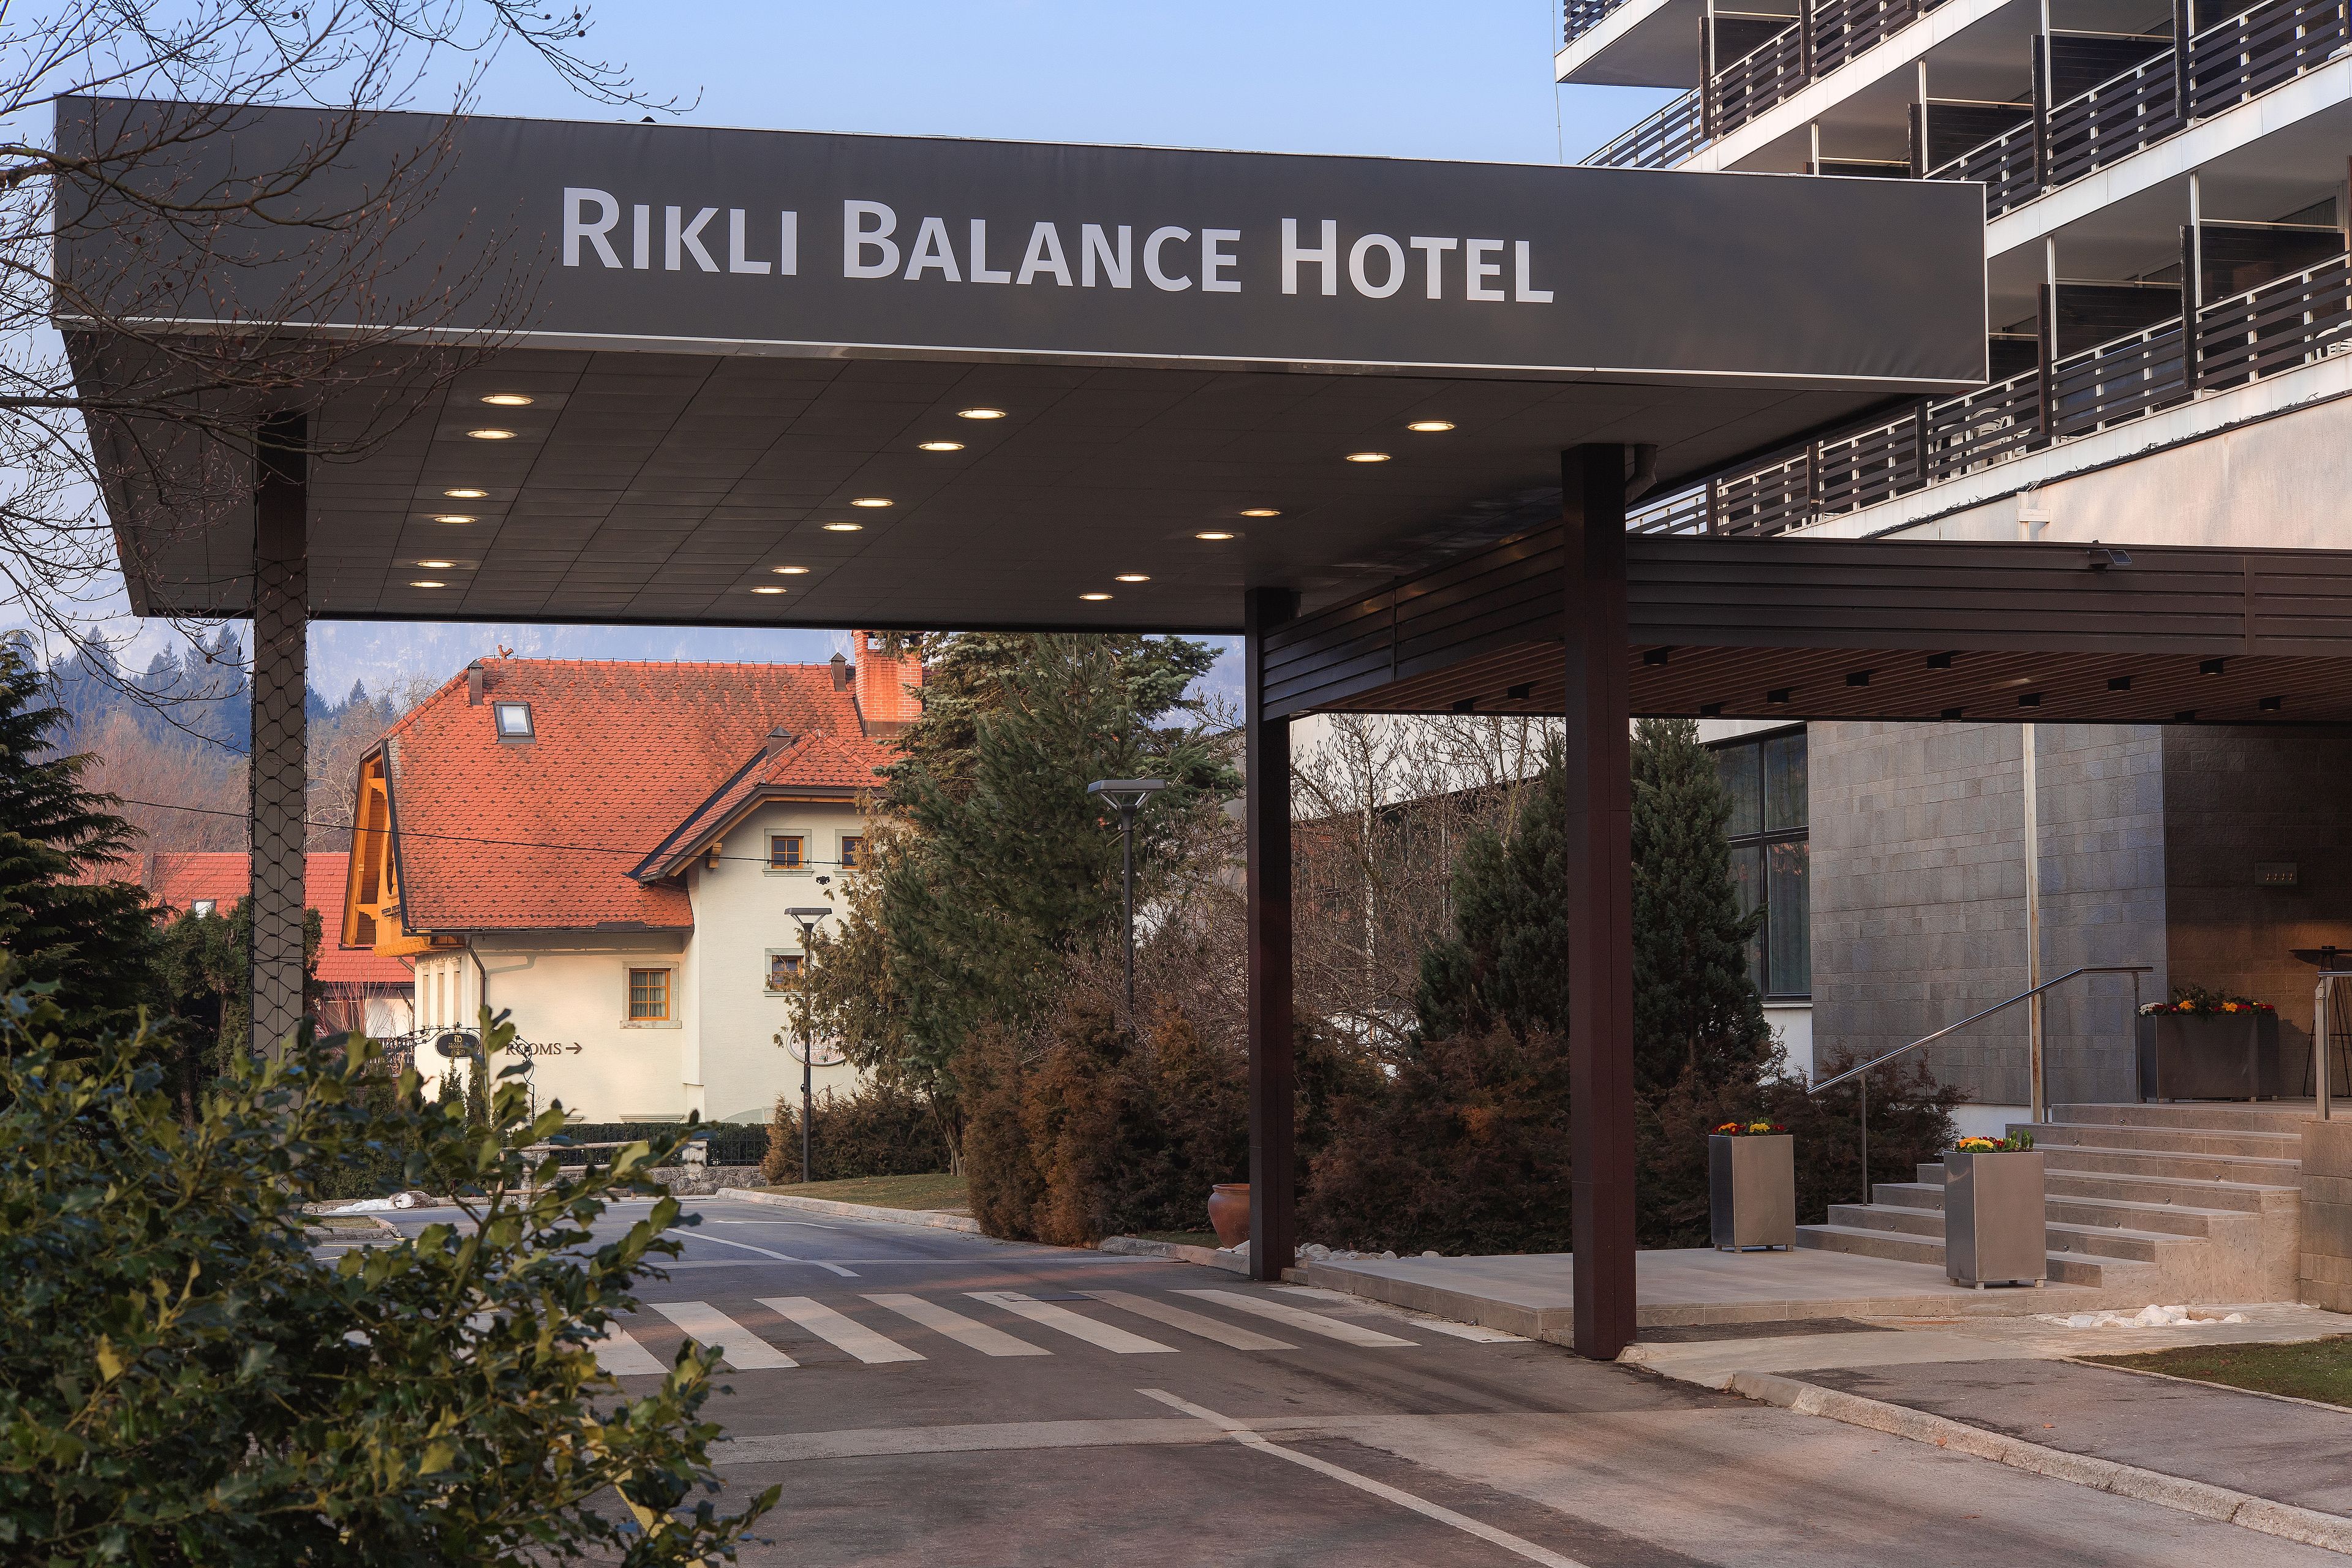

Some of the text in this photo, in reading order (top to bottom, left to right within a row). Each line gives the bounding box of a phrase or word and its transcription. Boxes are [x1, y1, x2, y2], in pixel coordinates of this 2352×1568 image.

[563, 187, 1554, 303] RIKLI BALANCE HOTEL
[505, 1042, 561, 1055] ROOMS
